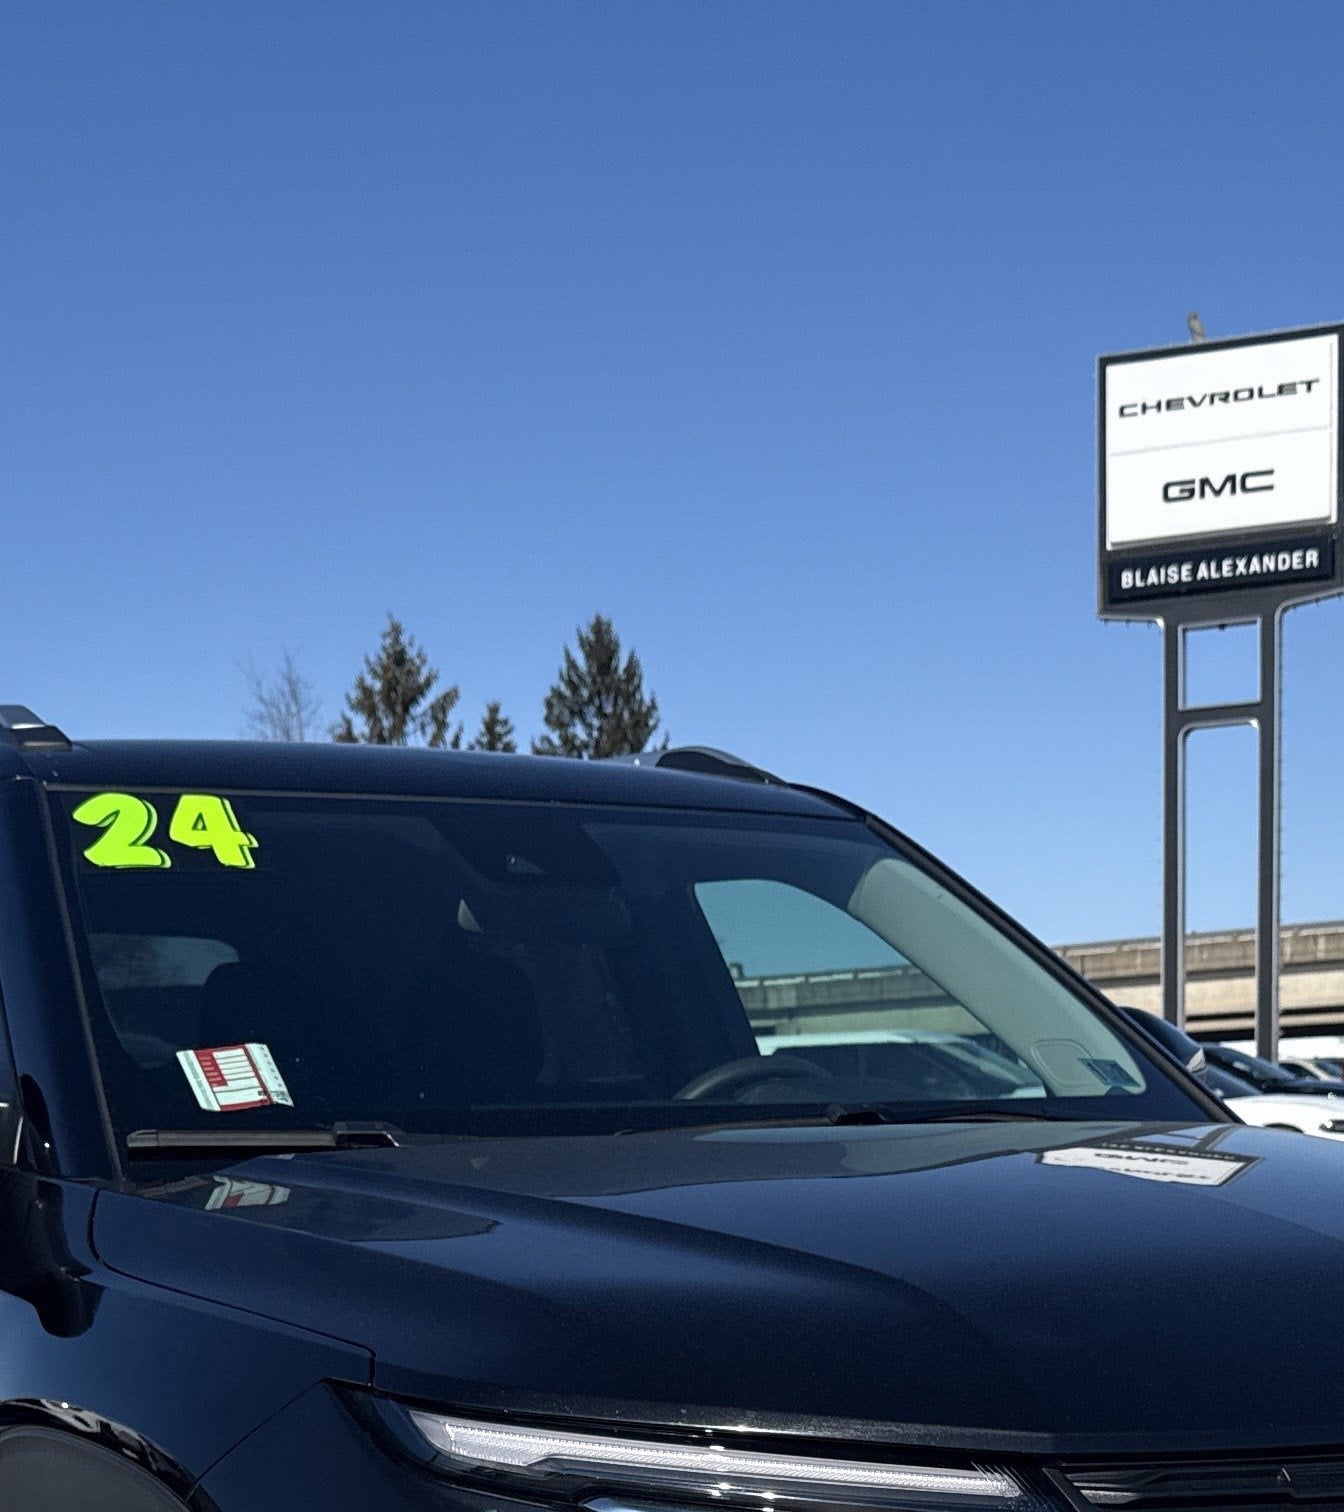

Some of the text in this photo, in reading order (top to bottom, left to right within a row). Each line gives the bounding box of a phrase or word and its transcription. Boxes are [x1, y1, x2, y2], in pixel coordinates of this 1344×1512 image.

[1118, 378, 1320, 418] CHEVROLET
[1161, 468, 1275, 503] GMC
[1121, 548, 1320, 589] BLAISE ALEXANDER
[72, 792, 259, 869] 24
